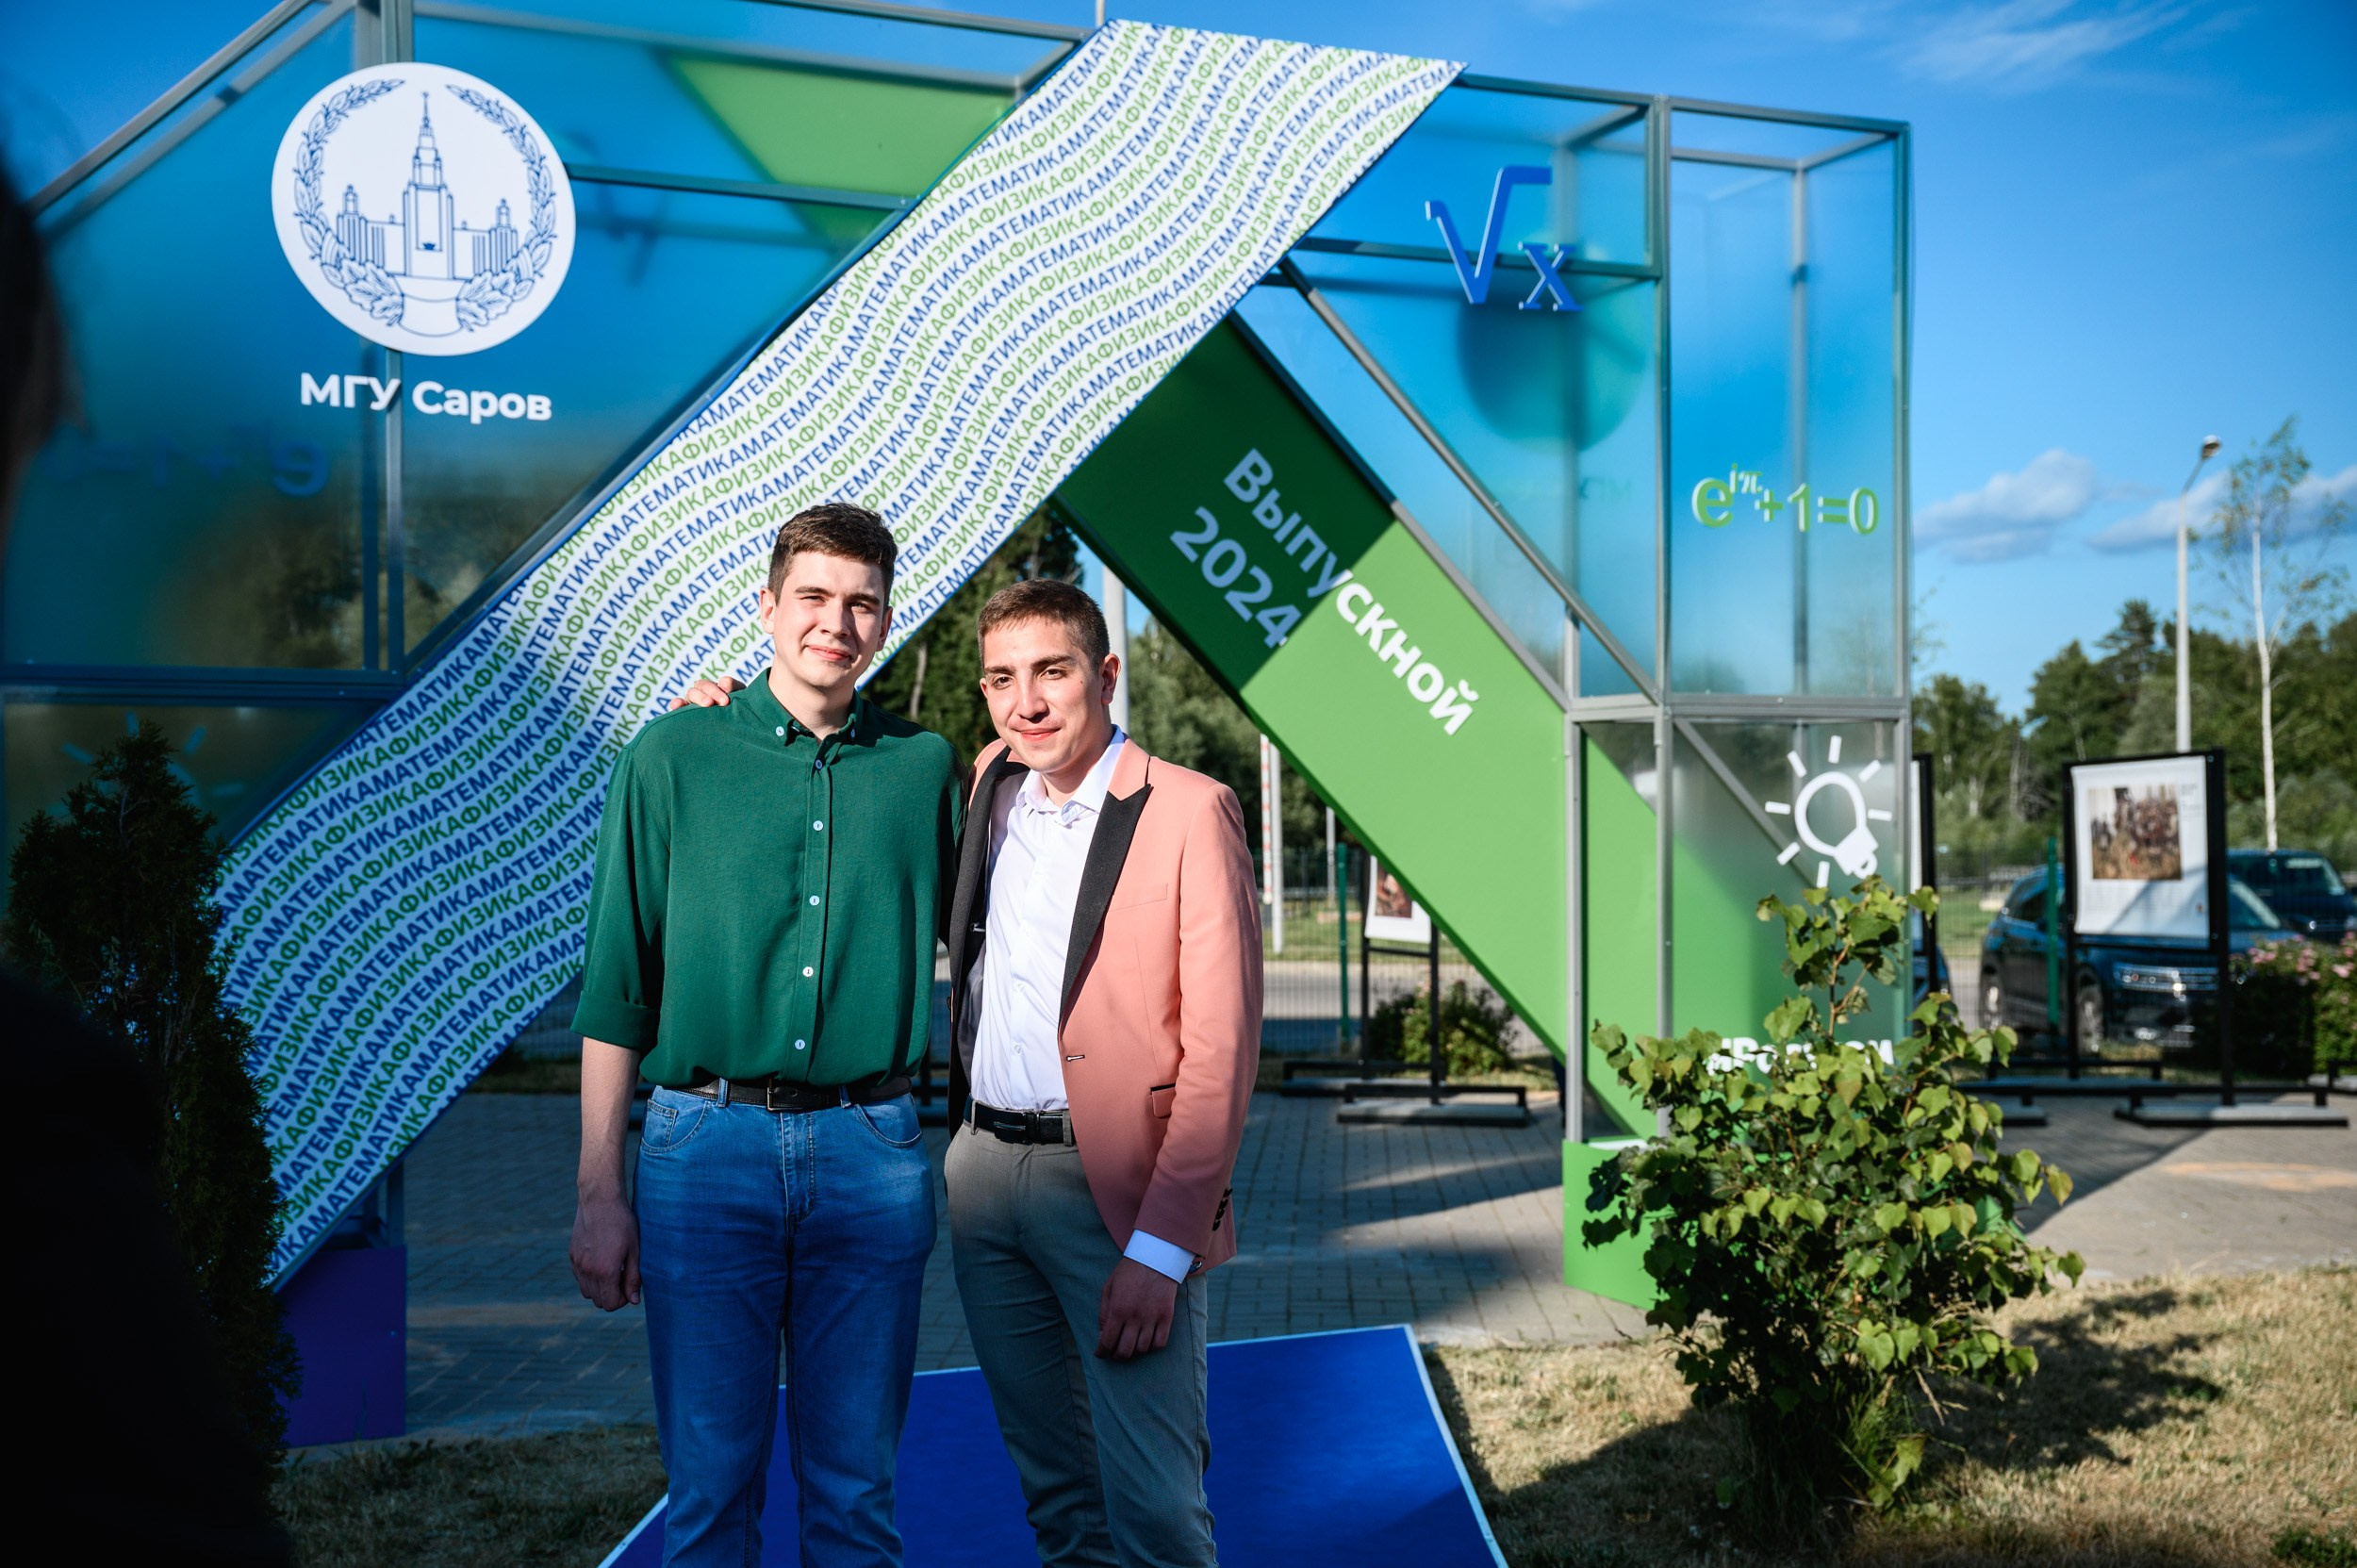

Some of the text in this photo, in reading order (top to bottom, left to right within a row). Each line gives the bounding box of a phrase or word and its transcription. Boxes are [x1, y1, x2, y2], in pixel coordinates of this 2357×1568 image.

[301, 371, 552, 424] МГУ Саров
[1169, 505, 1302, 649] 2024
[1223, 447, 1480, 736] Выпускной
